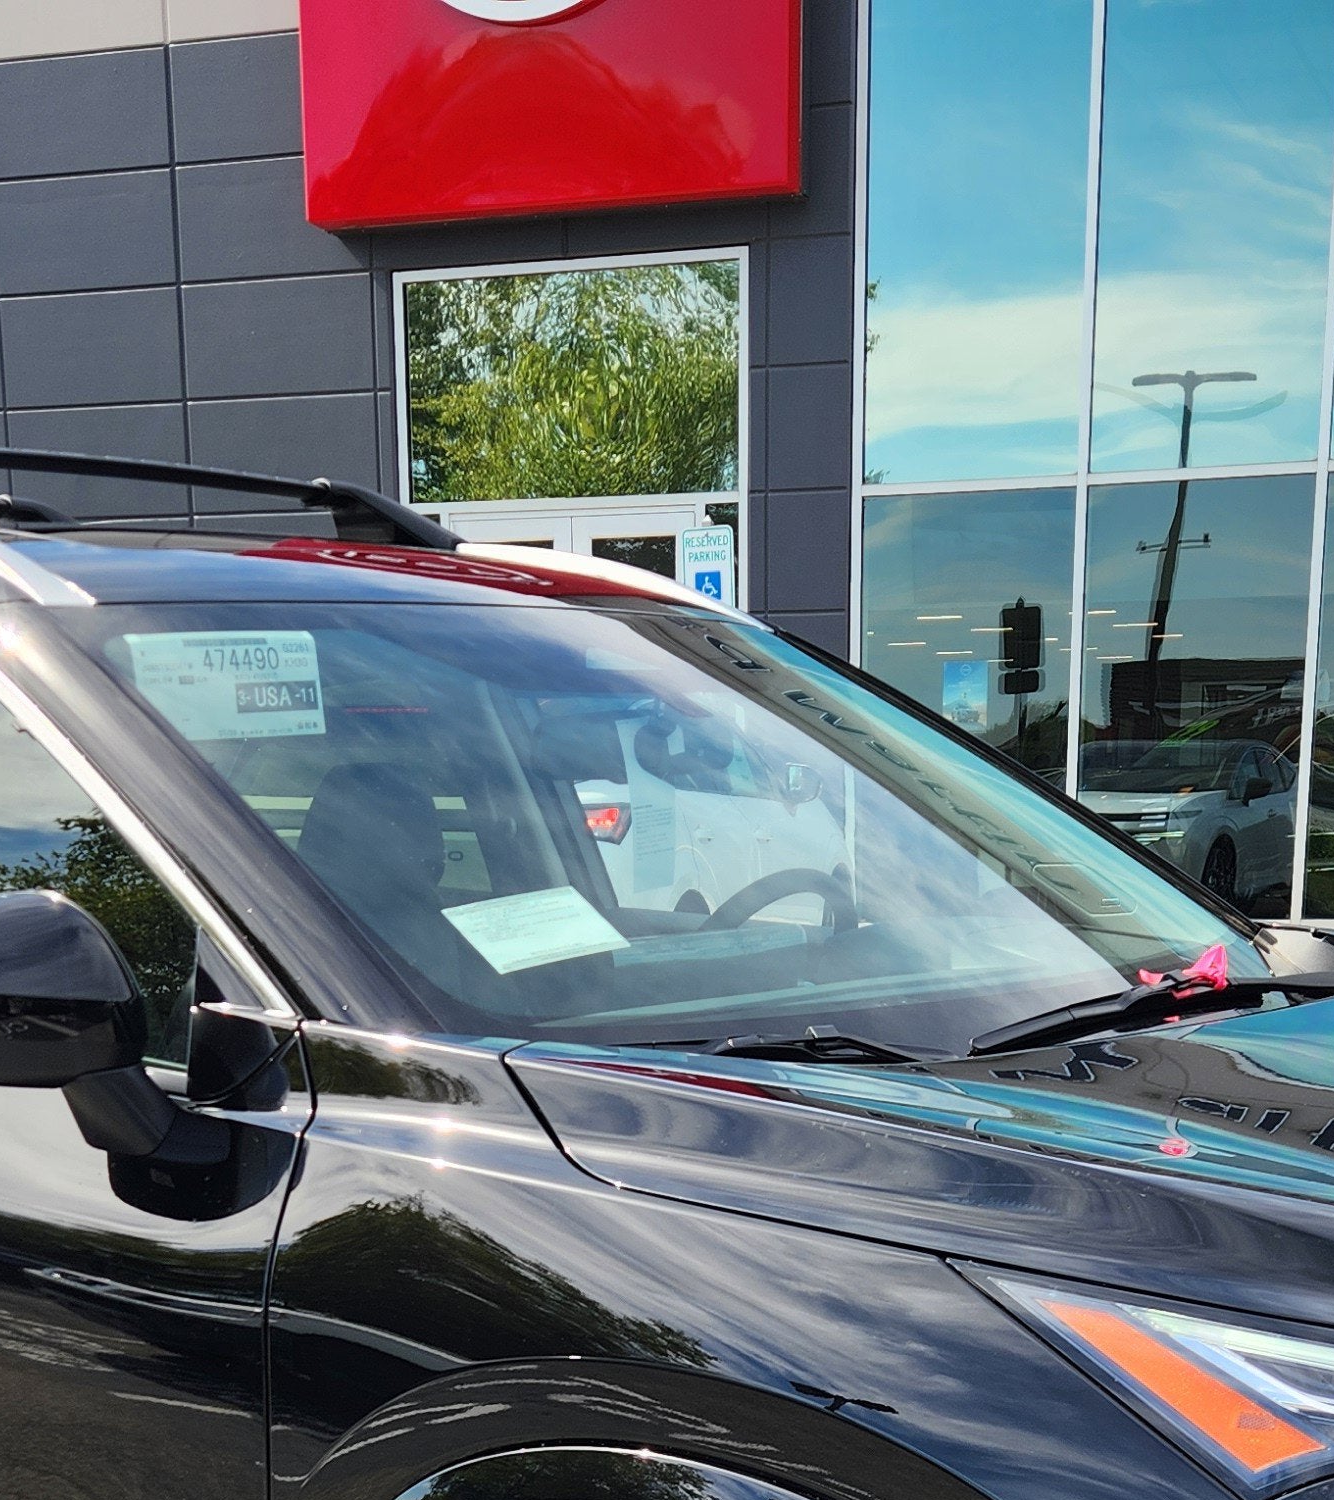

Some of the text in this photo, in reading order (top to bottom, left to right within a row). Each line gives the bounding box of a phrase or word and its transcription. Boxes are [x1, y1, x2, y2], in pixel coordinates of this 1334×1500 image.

[685, 535, 728, 548] RESERVED
[689, 550, 726, 562] PARKING
[203, 646, 280, 672] 474490
[255, 685, 292, 708] USA
